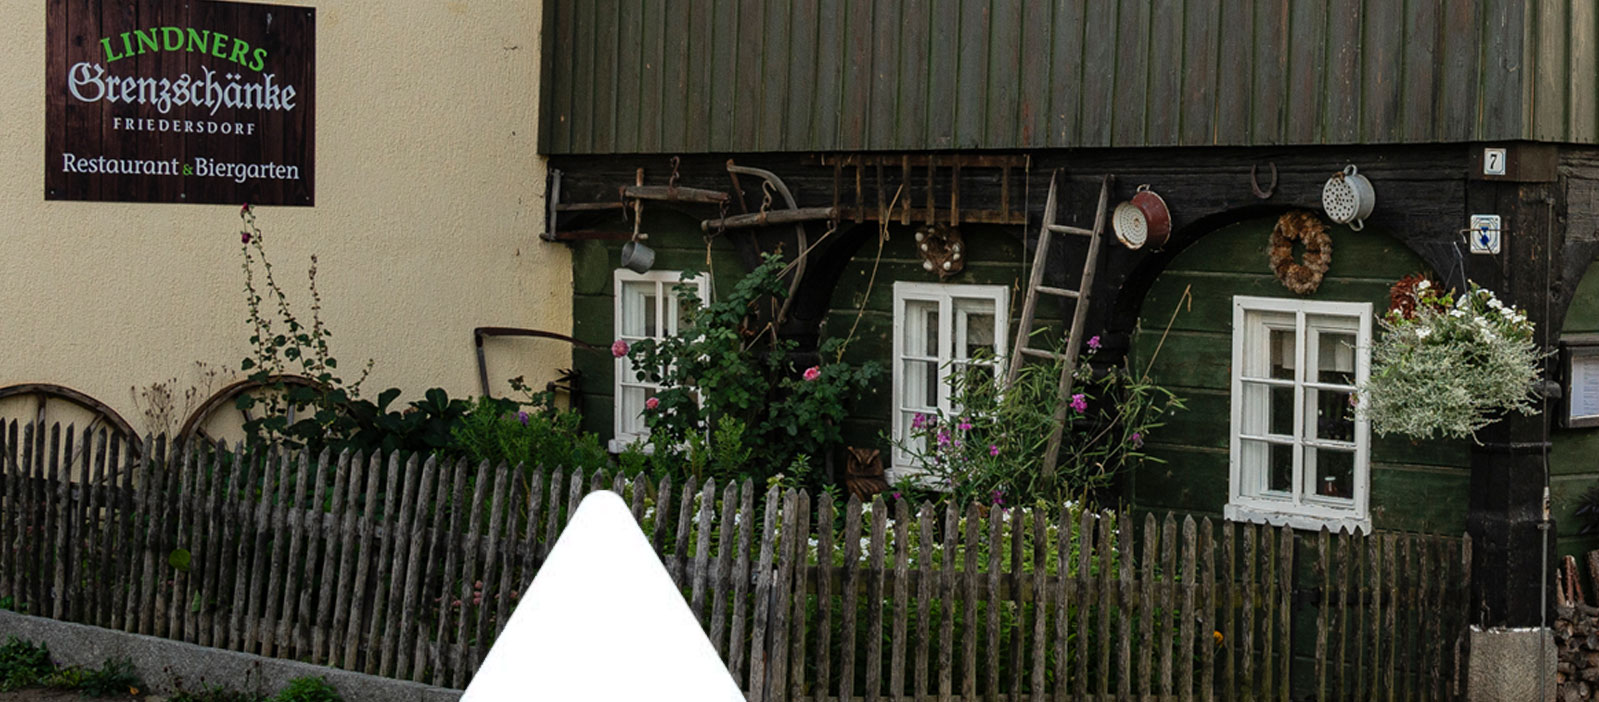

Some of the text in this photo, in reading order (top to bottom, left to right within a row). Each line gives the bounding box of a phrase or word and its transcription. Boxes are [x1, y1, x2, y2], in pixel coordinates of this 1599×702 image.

[100, 26, 268, 72] LINDNERS
[68, 61, 297, 116] Grenzschänke
[113, 117, 256, 136] FRIEDERSDORF
[62, 152, 300, 184] Restaurant & Biergarten
[1490, 153, 1497, 170] 7
